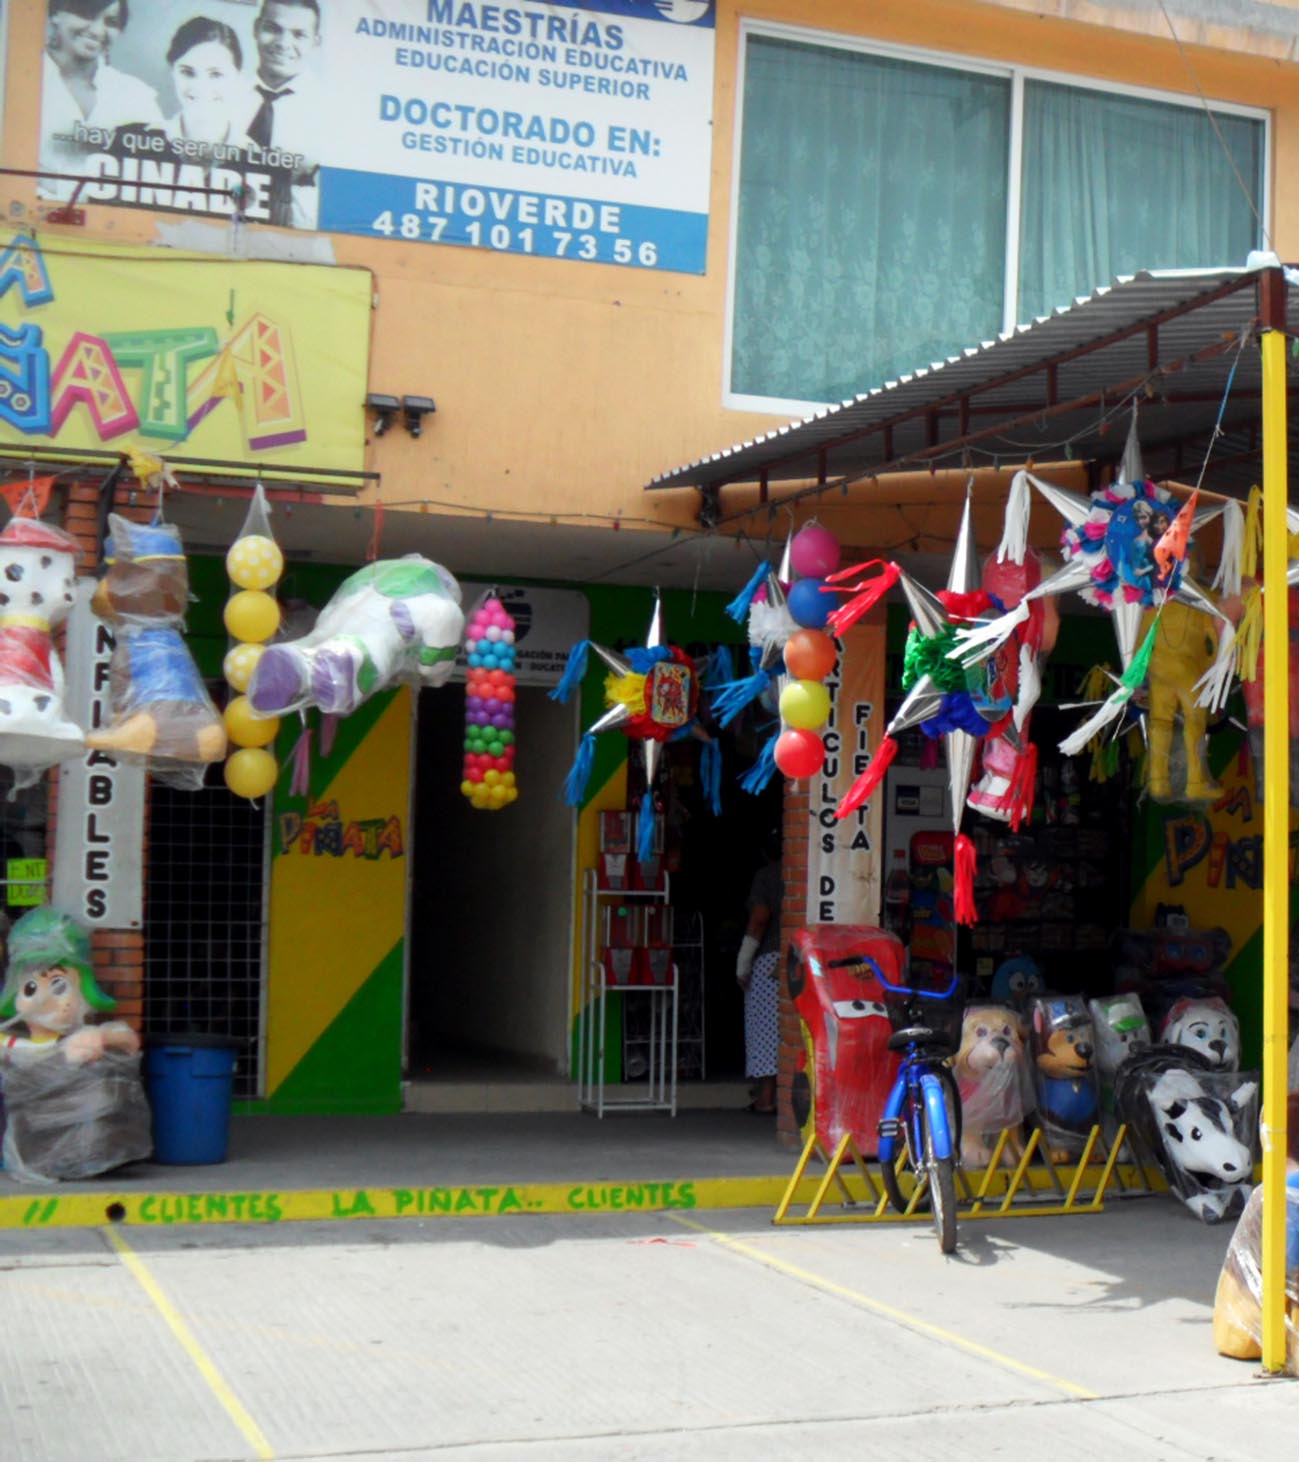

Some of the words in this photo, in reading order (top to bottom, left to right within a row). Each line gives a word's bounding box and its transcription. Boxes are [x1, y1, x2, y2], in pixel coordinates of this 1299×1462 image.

[355, 17, 557, 62] ADMINISTRACIÓN
[564, 49, 688, 82] EDUCATIVA
[428, 0, 625, 50] MAESTRÍAS
[395, 48, 530, 83] EDUCACIÓN
[538, 66, 651, 100] SUPERIOR
[122, 132, 165, 153] que
[172, 136, 209, 157] ser
[213, 143, 241, 161] un
[379, 94, 596, 148] DOCTORADO
[607, 125, 662, 157] EN:
[401, 131, 504, 161] GESTIÓN
[512, 146, 637, 178] EDUCATIVA
[415, 182, 621, 234] RIOVERDE
[372, 211, 447, 242] 487
[465, 221, 533, 253] 101
[553, 231, 598, 261] 73
[613, 239, 658, 266] 56
[851, 704, 871, 851] FIETA
[280, 812, 404, 861] PIÑATA
[819, 876, 836, 921] DE
[138, 1194, 282, 1222] CLIENTES
[332, 1191, 375, 1218] LA
[566, 1182, 698, 1210] CLIENTES
